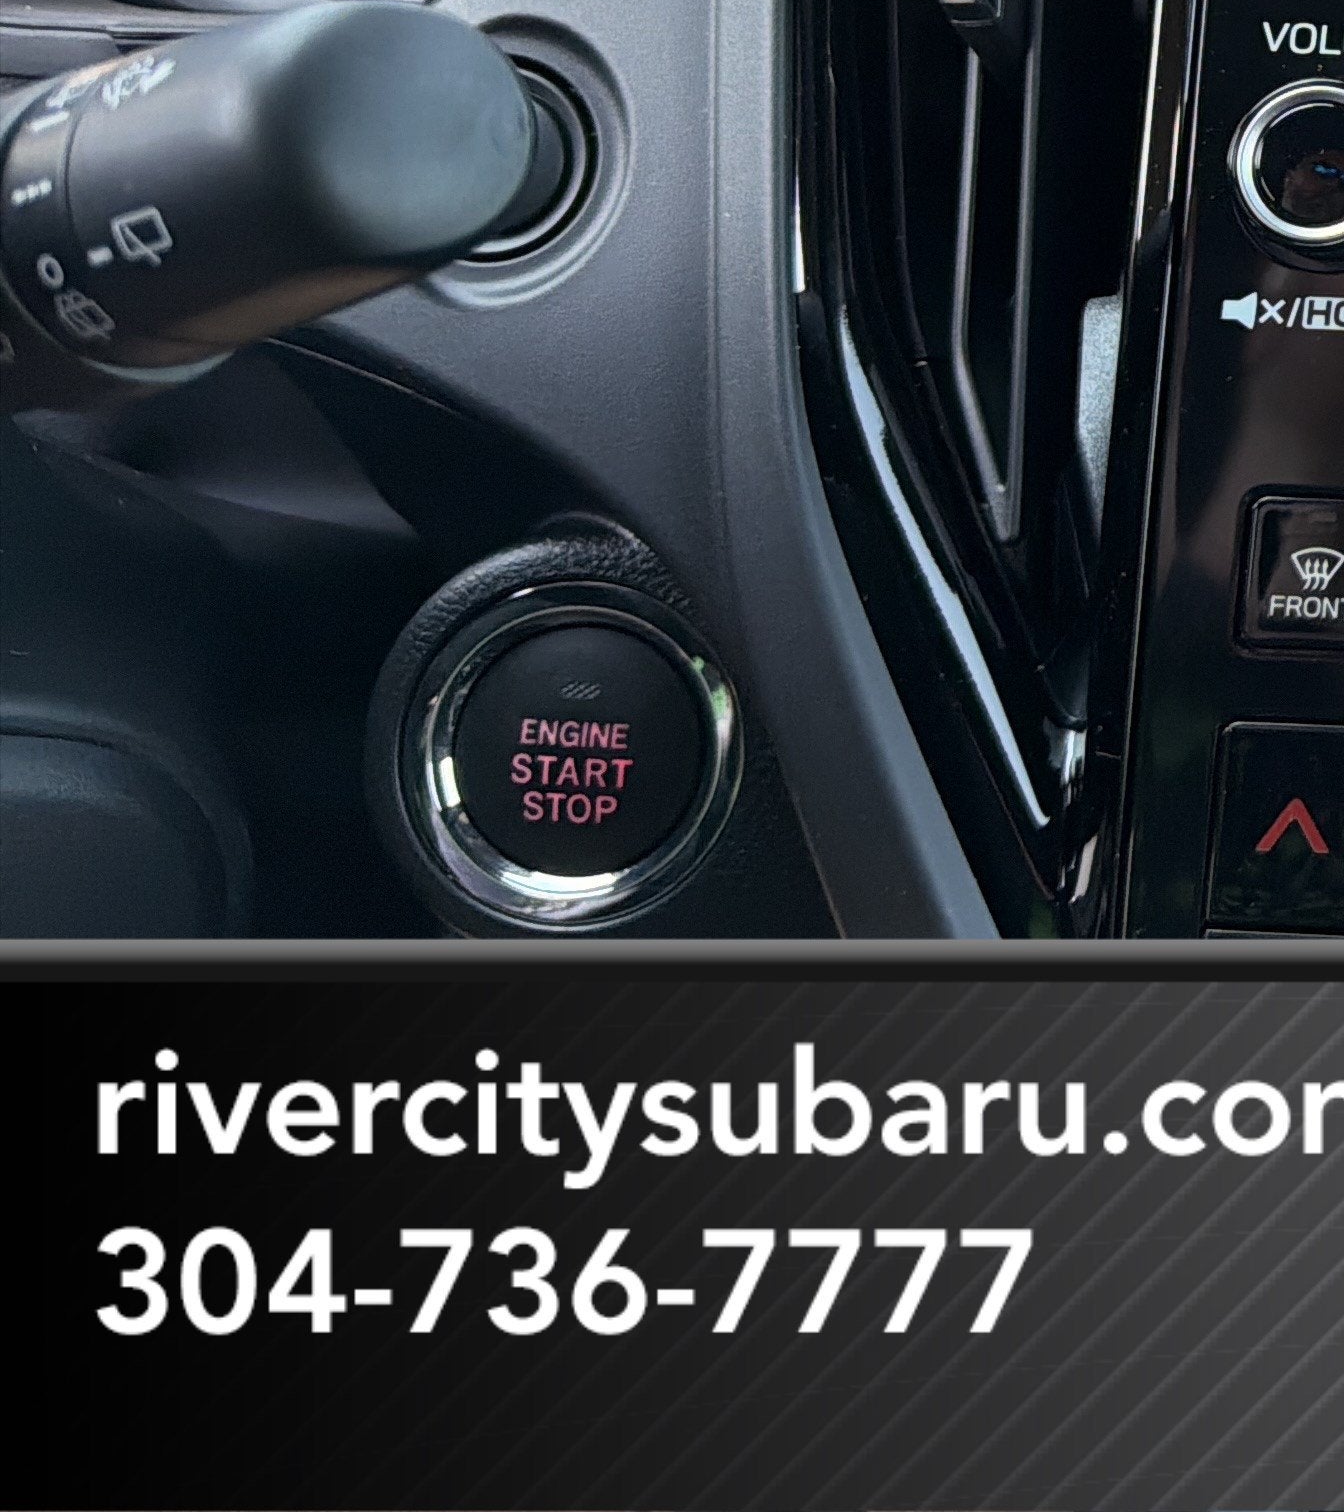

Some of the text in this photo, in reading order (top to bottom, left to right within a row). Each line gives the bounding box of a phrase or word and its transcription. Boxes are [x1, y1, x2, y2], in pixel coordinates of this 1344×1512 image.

[519, 717, 629, 750] ENGINE
[510, 752, 635, 790] START
[522, 789, 619, 825] STOP
